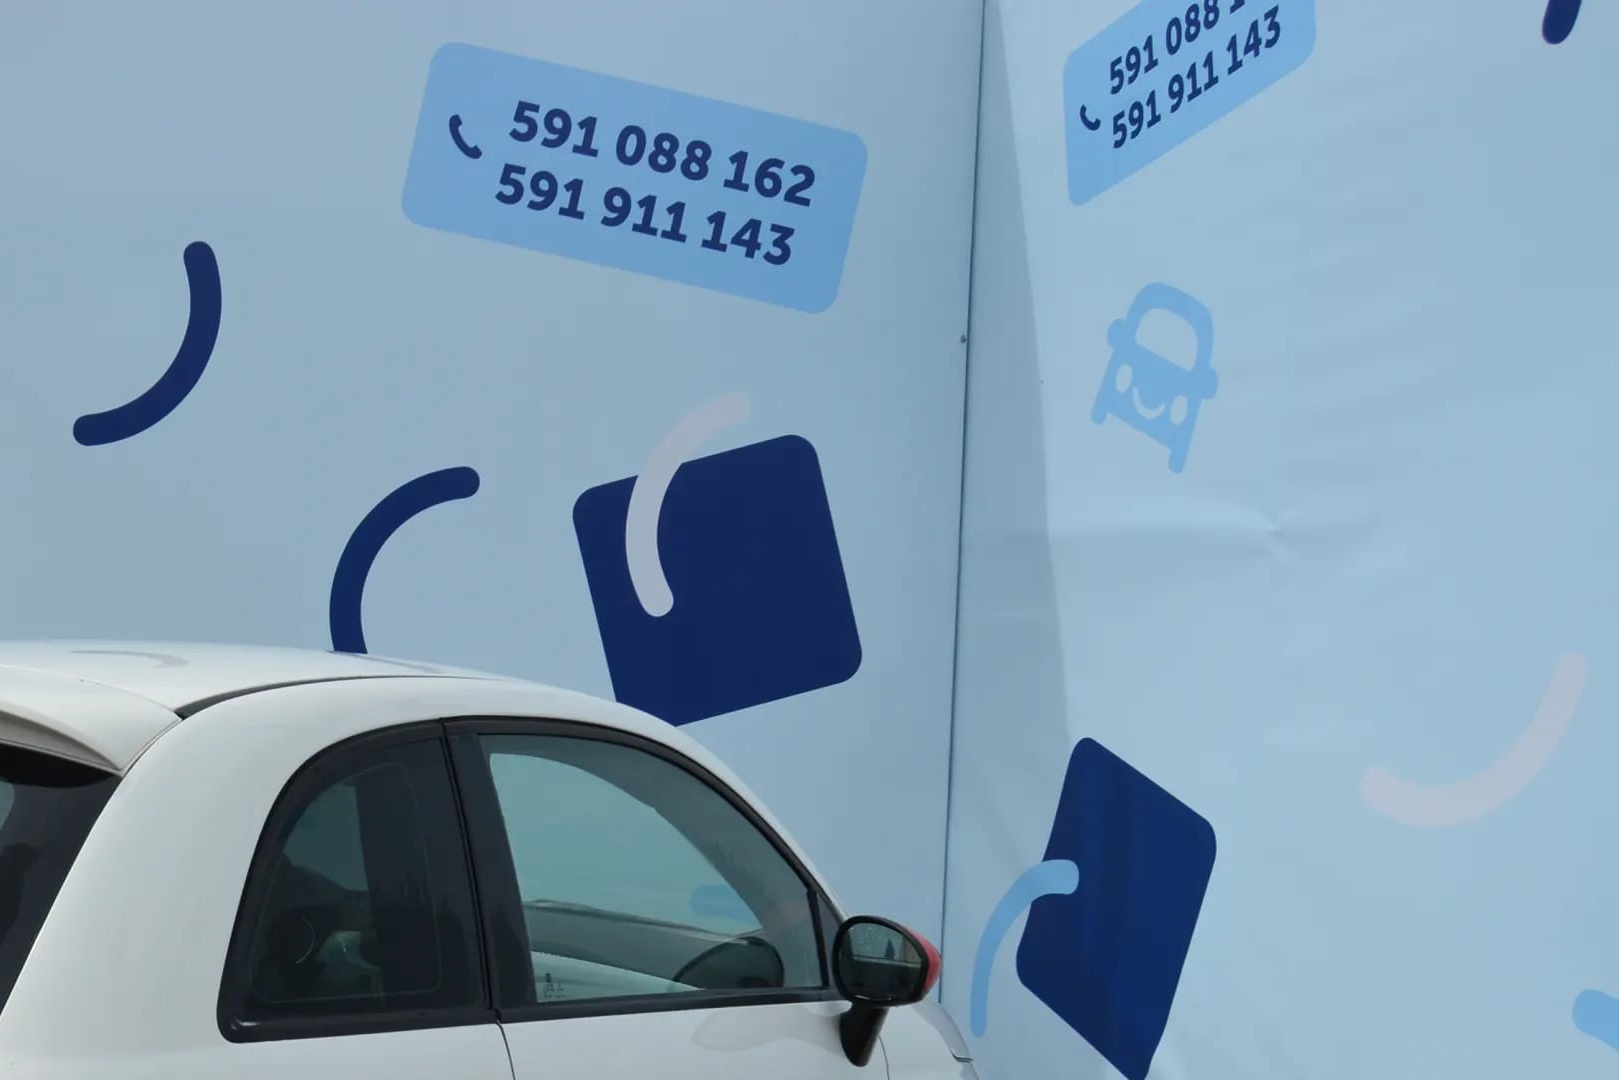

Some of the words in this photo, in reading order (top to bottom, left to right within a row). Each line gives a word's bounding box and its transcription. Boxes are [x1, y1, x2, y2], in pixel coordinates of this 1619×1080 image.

[1110, 34, 1159, 95] 591
[1165, 0, 1220, 55] 088
[1113, 91, 1161, 149] 591
[1168, 52, 1219, 114] 911
[1226, 5, 1281, 75] 143
[509, 100, 599, 159] 591
[615, 125, 712, 181] 088
[723, 150, 815, 207] 162
[495, 163, 585, 220] 591
[600, 186, 687, 243] 911
[701, 210, 795, 266] 143
